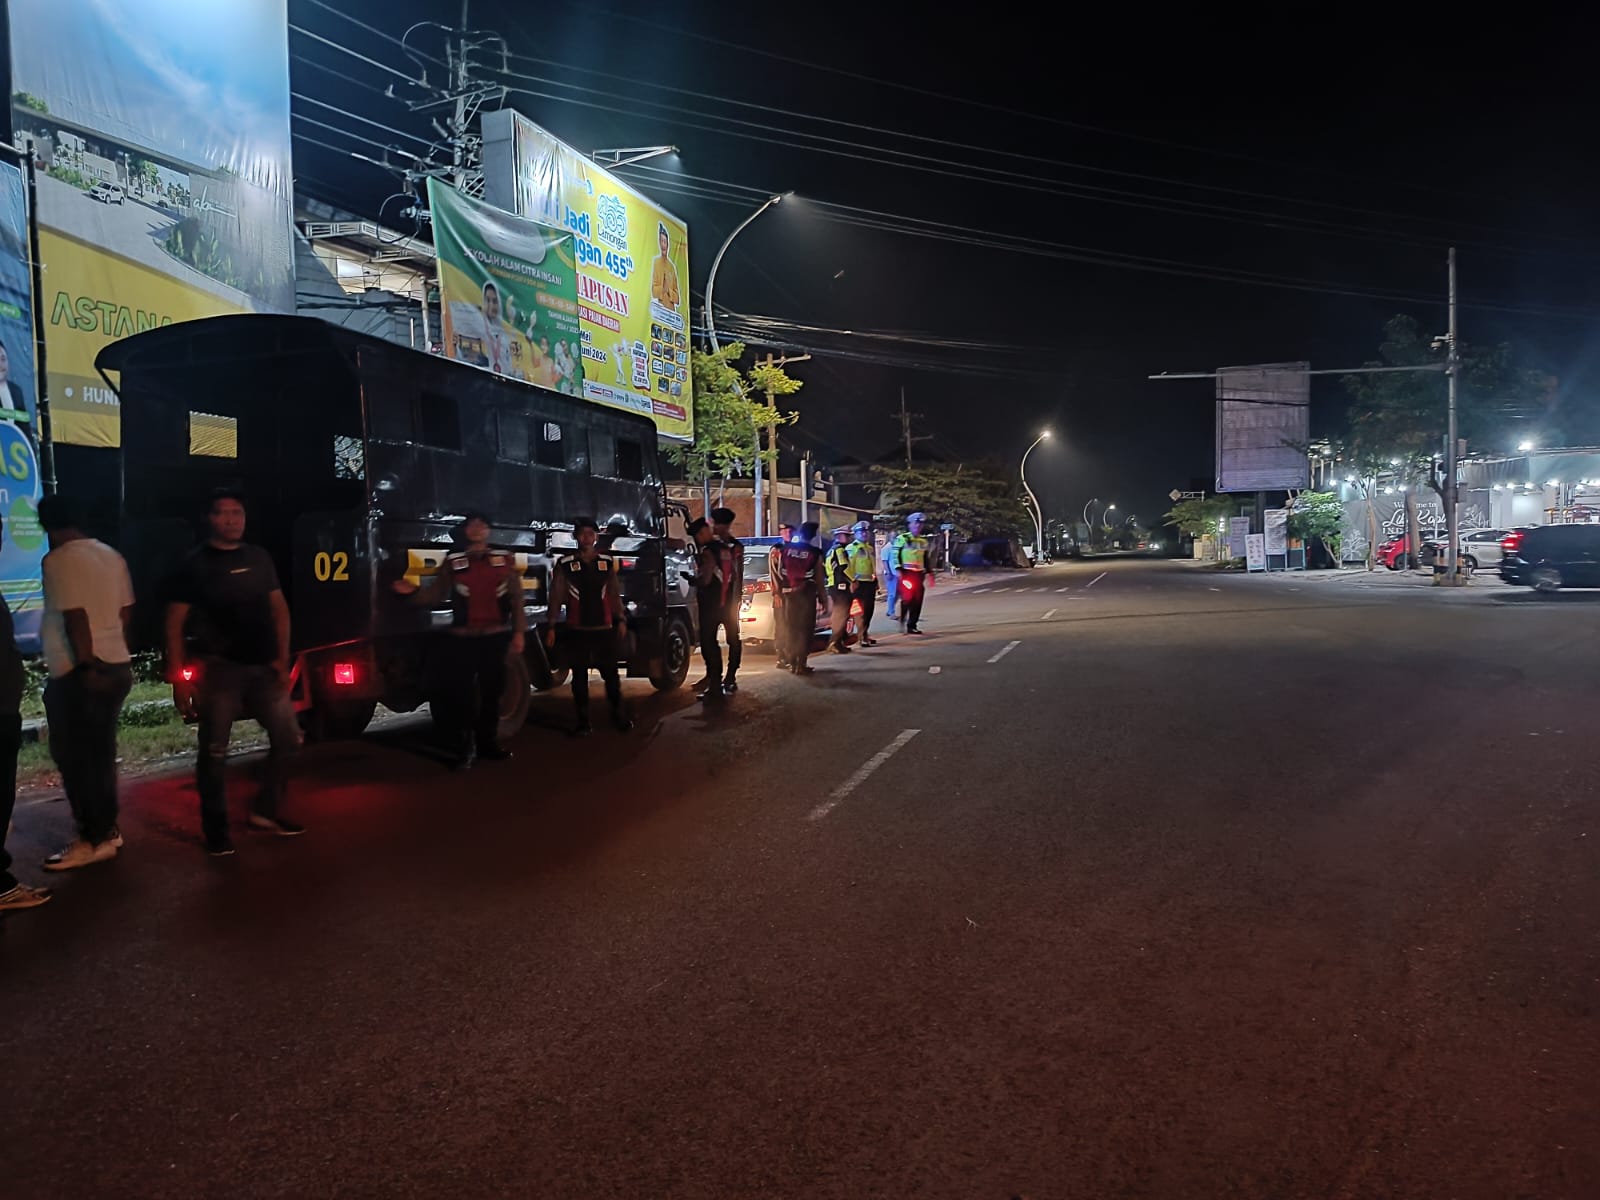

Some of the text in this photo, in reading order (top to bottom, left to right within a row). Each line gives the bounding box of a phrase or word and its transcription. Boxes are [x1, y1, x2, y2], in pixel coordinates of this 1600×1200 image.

[564, 206, 591, 237] Jadi
[597, 223, 627, 250] Lamongan
[500, 258, 520, 273] ALAM
[521, 264, 541, 280] CITRA
[541, 271, 562, 285] INSANI
[581, 346, 606, 361] uni 2024
[314, 551, 350, 582] 02
